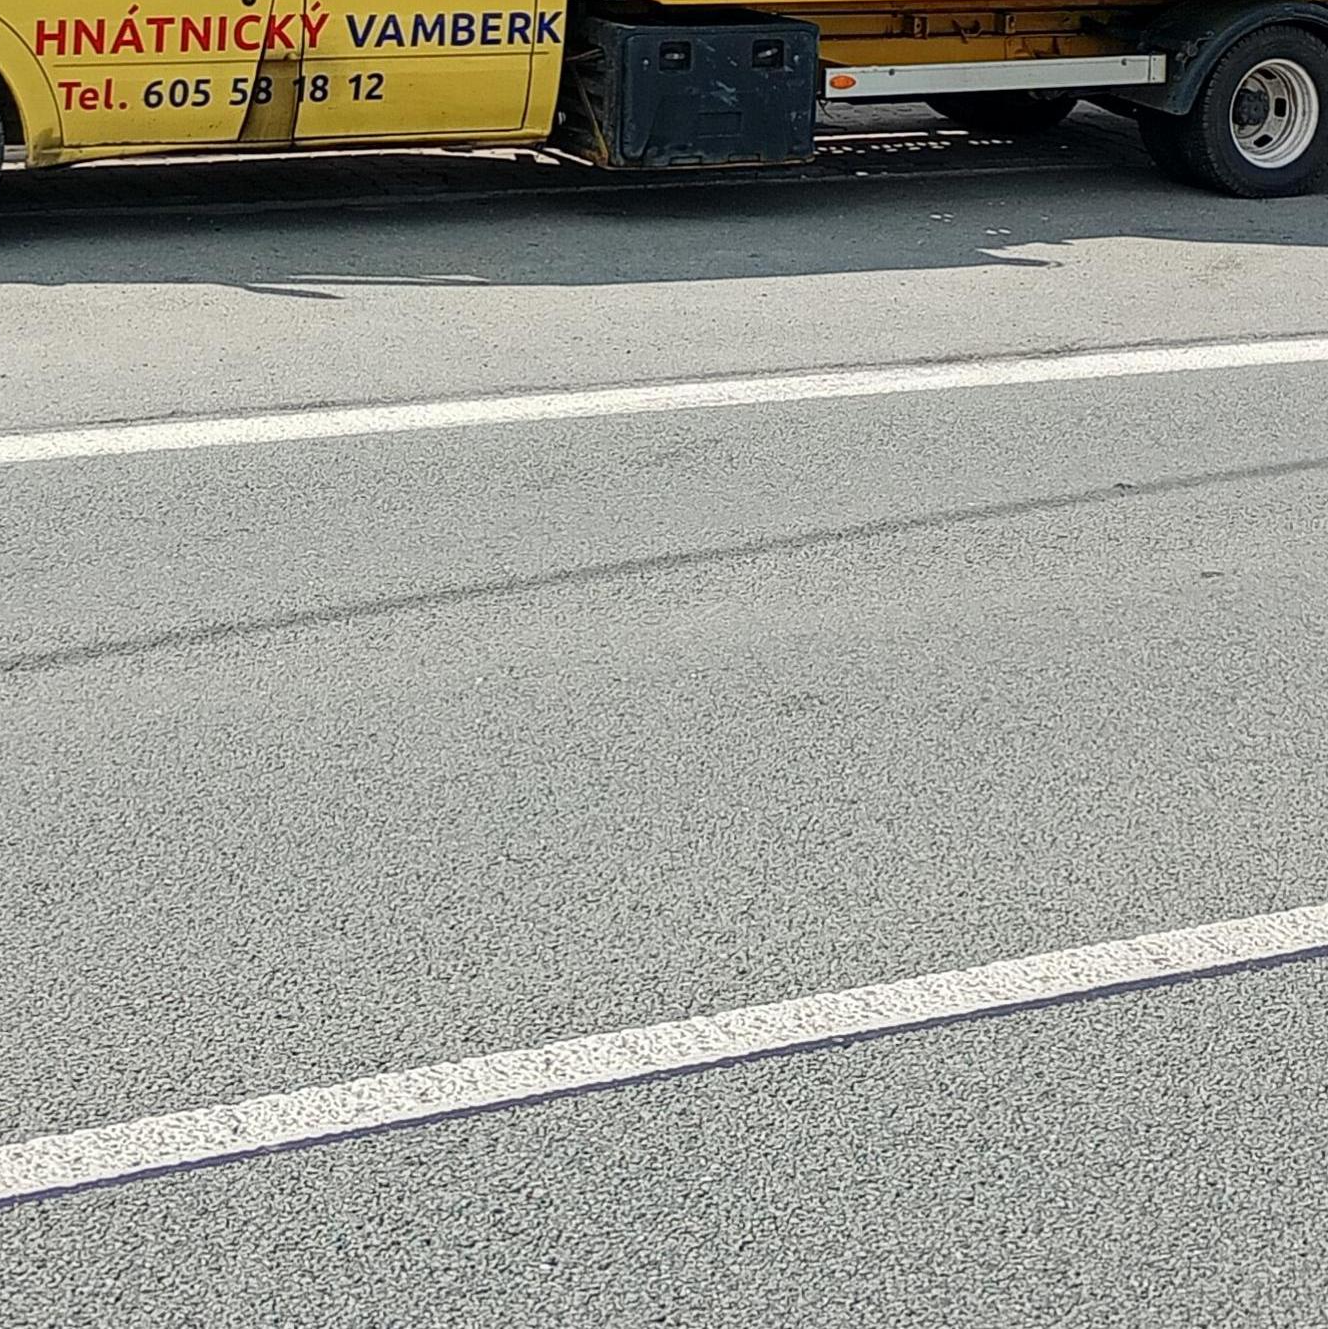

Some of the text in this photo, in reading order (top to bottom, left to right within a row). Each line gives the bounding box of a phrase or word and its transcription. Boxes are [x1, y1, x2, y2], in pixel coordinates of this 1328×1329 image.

[34, 1, 564, 57] HNÁTNICKÝ VAMBERK
[58, 72, 385, 111] Tel. 605 58 18 12
